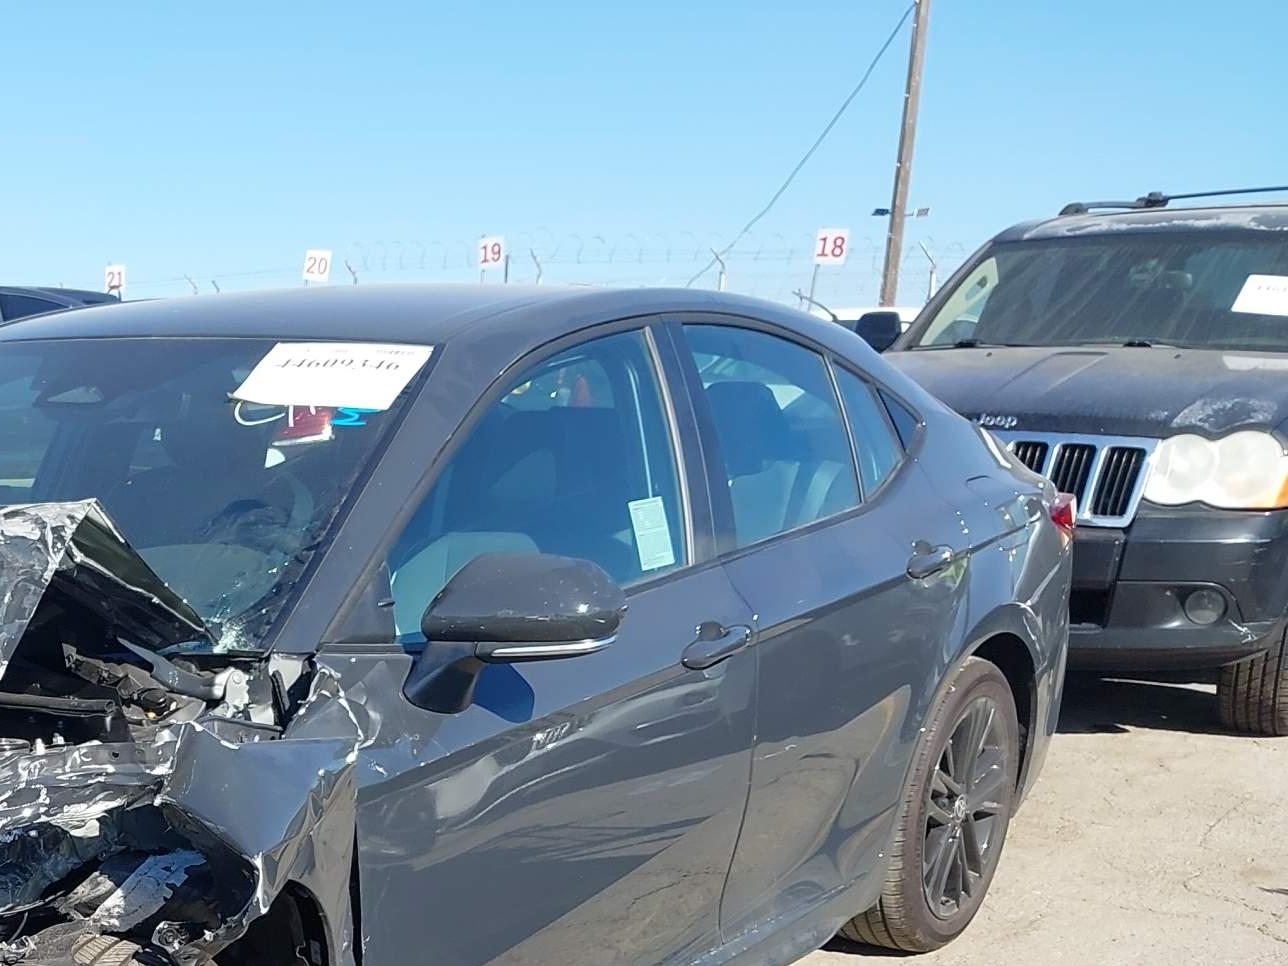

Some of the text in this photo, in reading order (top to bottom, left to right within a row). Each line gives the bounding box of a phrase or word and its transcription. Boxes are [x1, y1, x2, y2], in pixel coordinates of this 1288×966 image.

[480, 243, 501, 263] 19
[816, 236, 846, 258] 18
[306, 256, 328, 275] 20
[107, 271, 123, 288] 21
